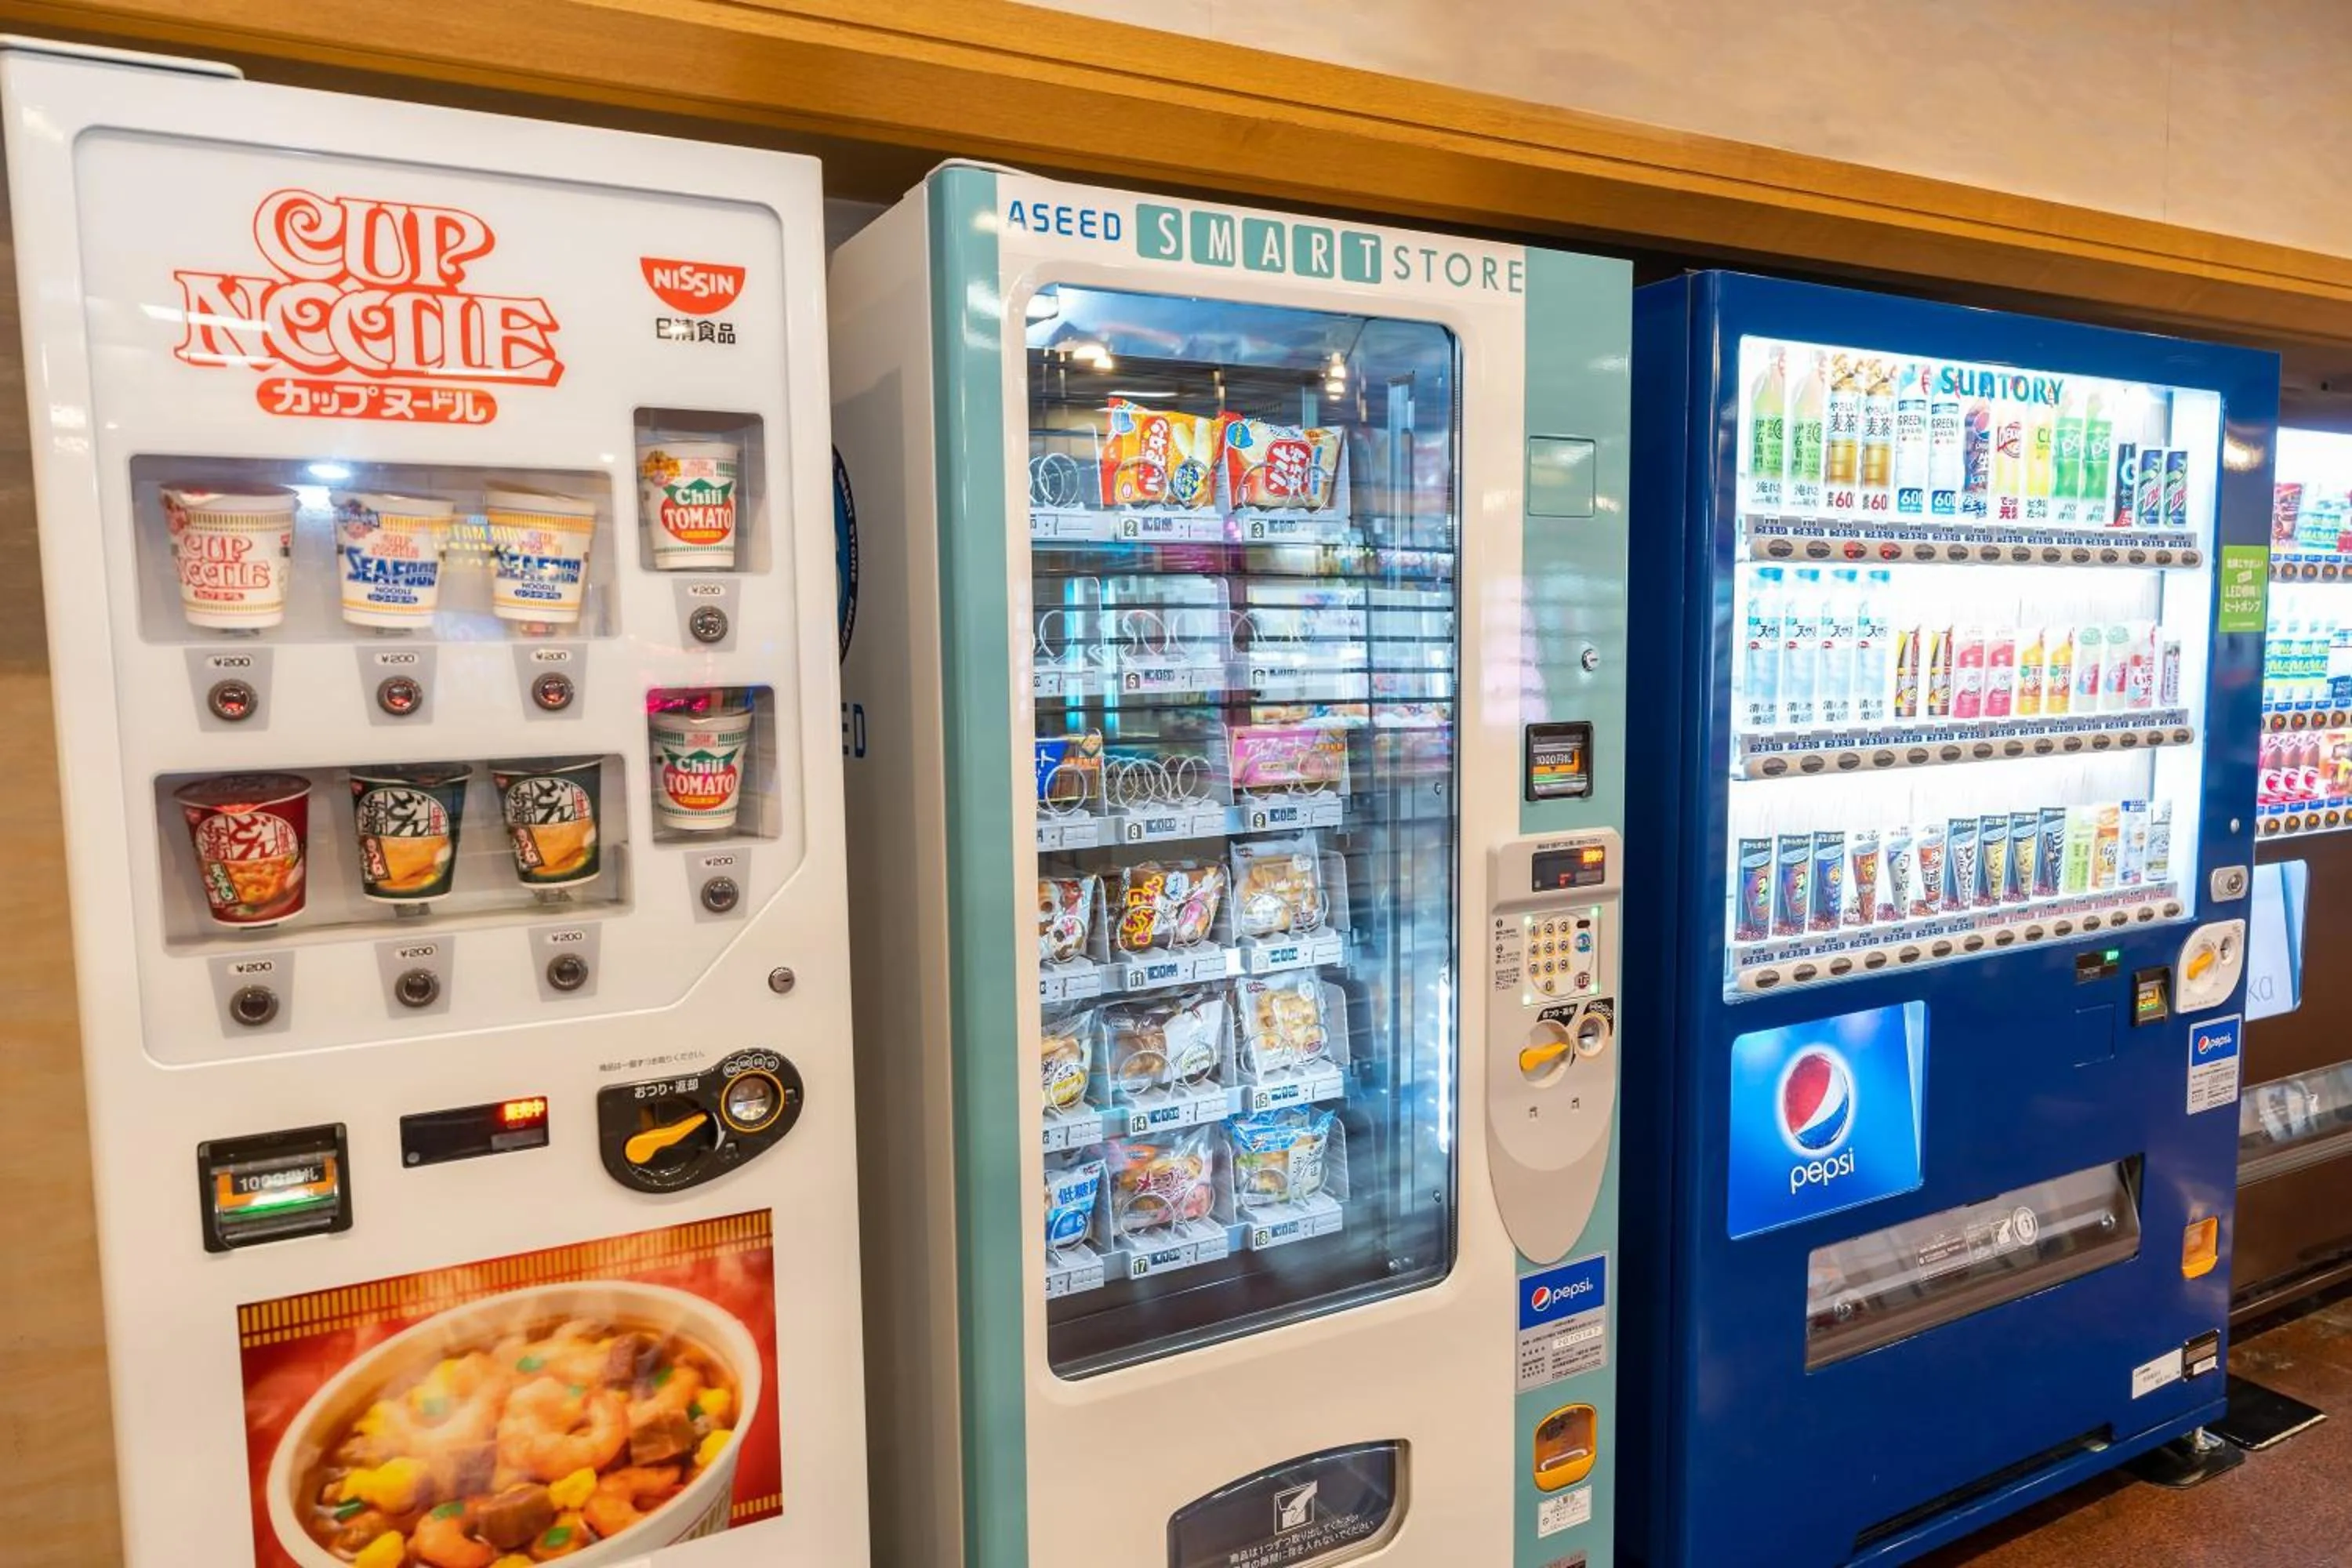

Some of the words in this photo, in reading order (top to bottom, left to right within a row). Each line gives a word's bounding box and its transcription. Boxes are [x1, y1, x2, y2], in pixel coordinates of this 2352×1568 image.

[253, 189, 495, 290] CUP
[1008, 201, 1121, 241] ASEED
[1158, 212, 1374, 278] SMART
[1393, 245, 1523, 293] STORE
[652, 265, 735, 298] NISSIN
[174, 270, 564, 387] NOODLE
[1940, 365, 2064, 405] SUNTORY
[273, 381, 486, 421] カップヌードル
[675, 488, 723, 506] Chili
[665, 508, 731, 529] TOMATO
[180, 535, 252, 564] CUP
[346, 546, 438, 587] SEAFOOD
[214, 657, 251, 668] ¥200
[381, 654, 416, 664] ¥200
[676, 757, 725, 773] Chili
[666, 772, 737, 794] TOMATO
[552, 931, 583, 942] ¥200
[401, 946, 434, 957] ¥200
[236, 962, 273, 974] ¥200
[634, 1078, 699, 1098] おつり・返却
[1790, 1147, 1855, 1195] pepsi
[1552, 1276, 1591, 1304] pepsi
